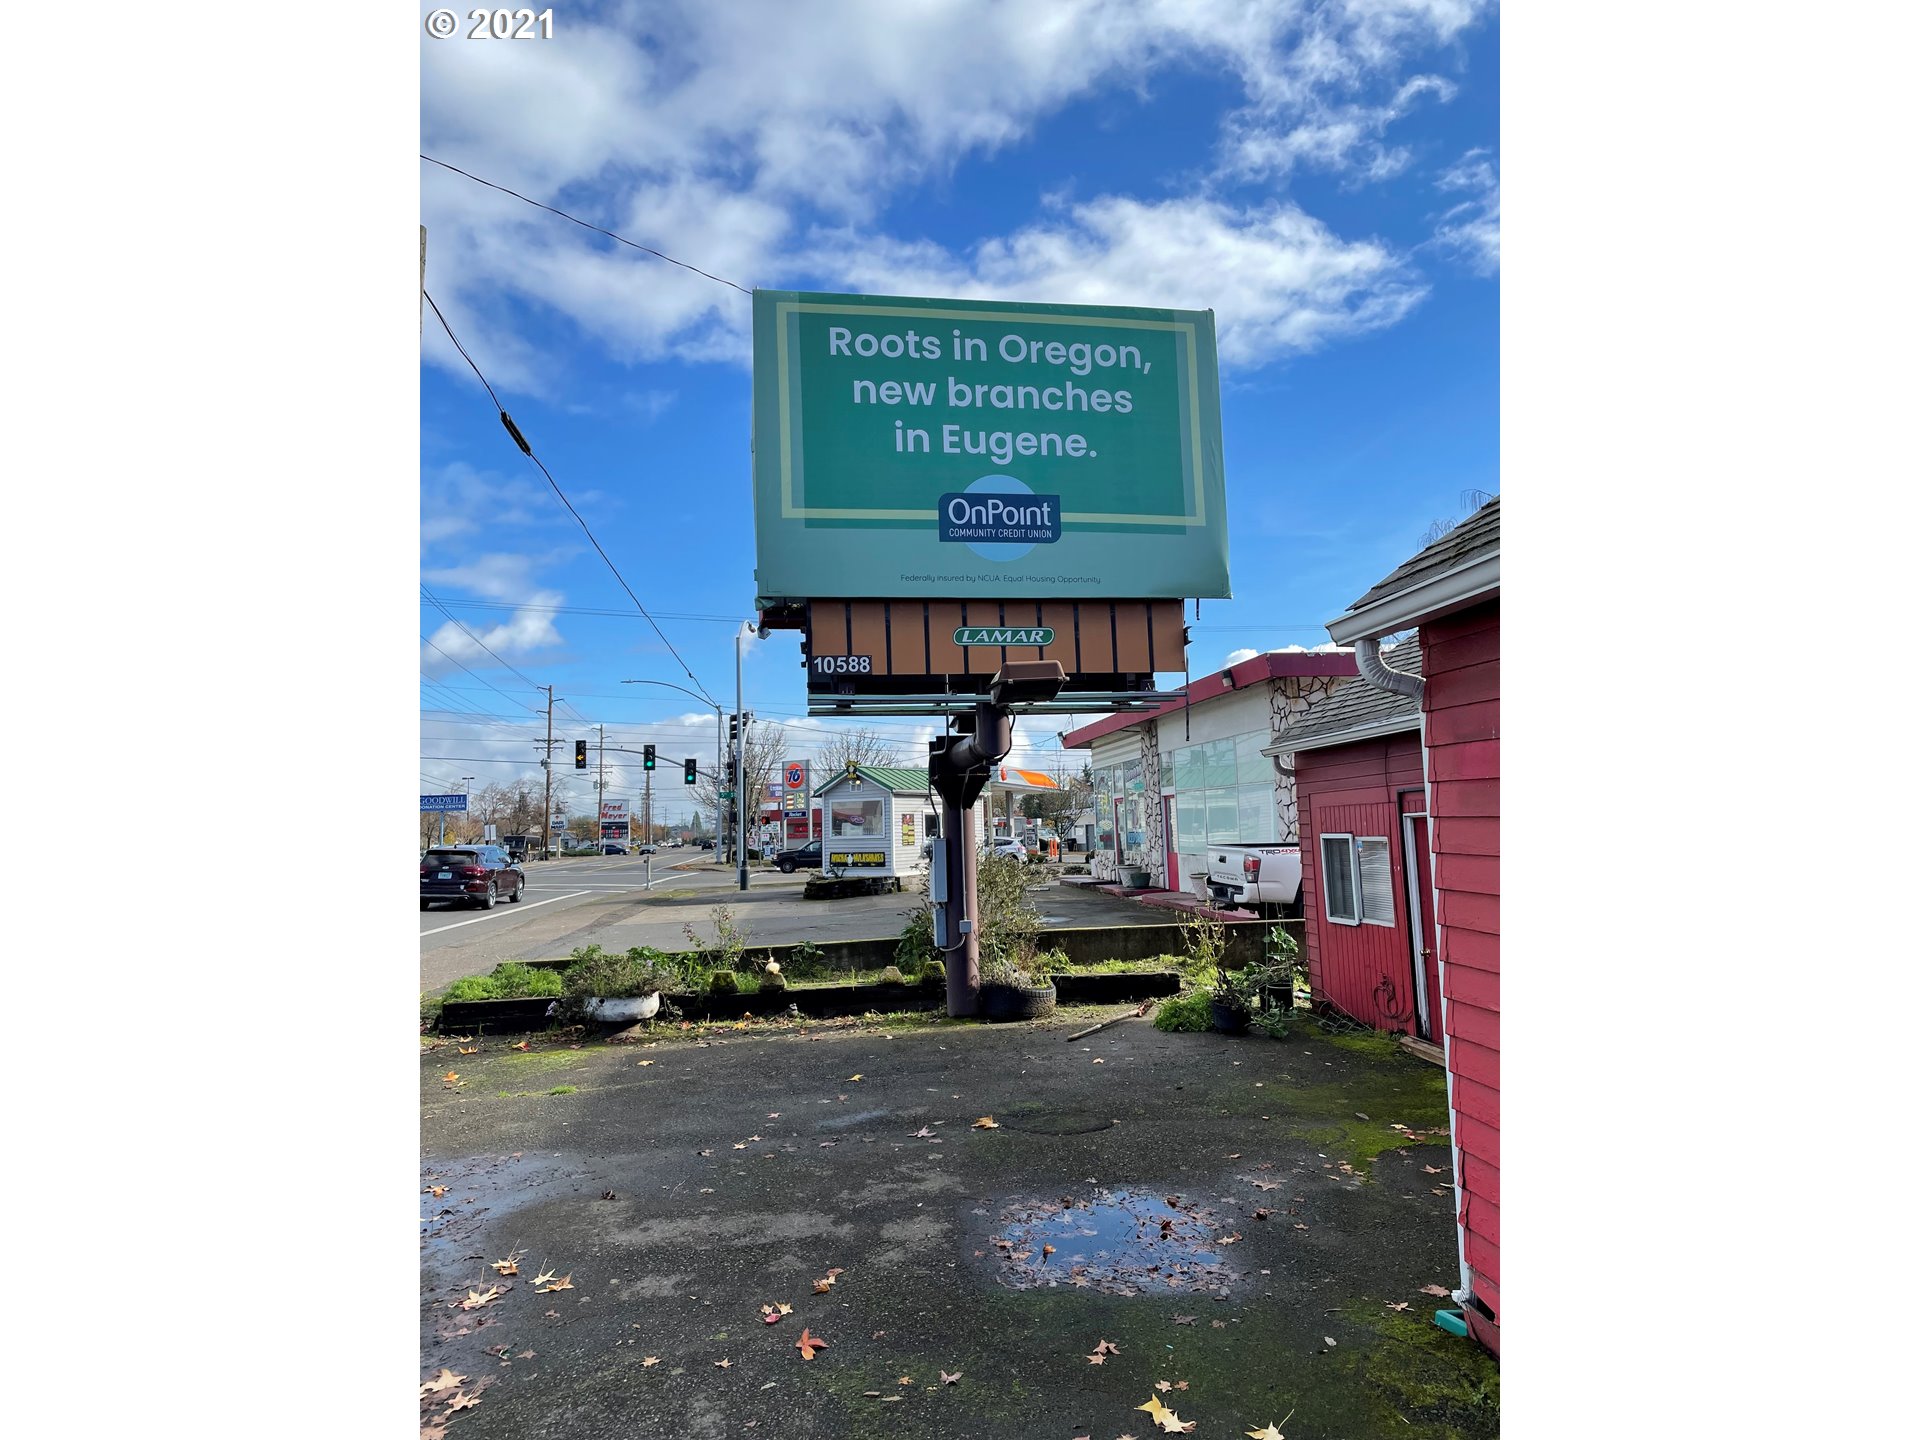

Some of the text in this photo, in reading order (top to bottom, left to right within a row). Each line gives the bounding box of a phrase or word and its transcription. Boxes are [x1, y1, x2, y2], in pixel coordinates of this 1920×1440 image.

[829, 326, 1152, 376] Roots in Oregon,
[853, 376, 1134, 413] new branches
[895, 419, 1098, 465] in Eugene.
[948, 498, 1052, 526] OnPoint
[949, 528, 1052, 538] COMMUNITY CREDIT UNION
[900, 574, 936, 583] Federally
[936, 574, 964, 582] insured
[966, 574, 976, 583] by
[1003, 574, 1024, 583] Equal
[1025, 575, 1056, 584] Housing
[961, 630, 1045, 643] LAMAR
[813, 656, 871, 674] 10588
[787, 768, 801, 783] 76
[602, 802, 623, 811] Fred
[600, 811, 627, 820] Meyer
